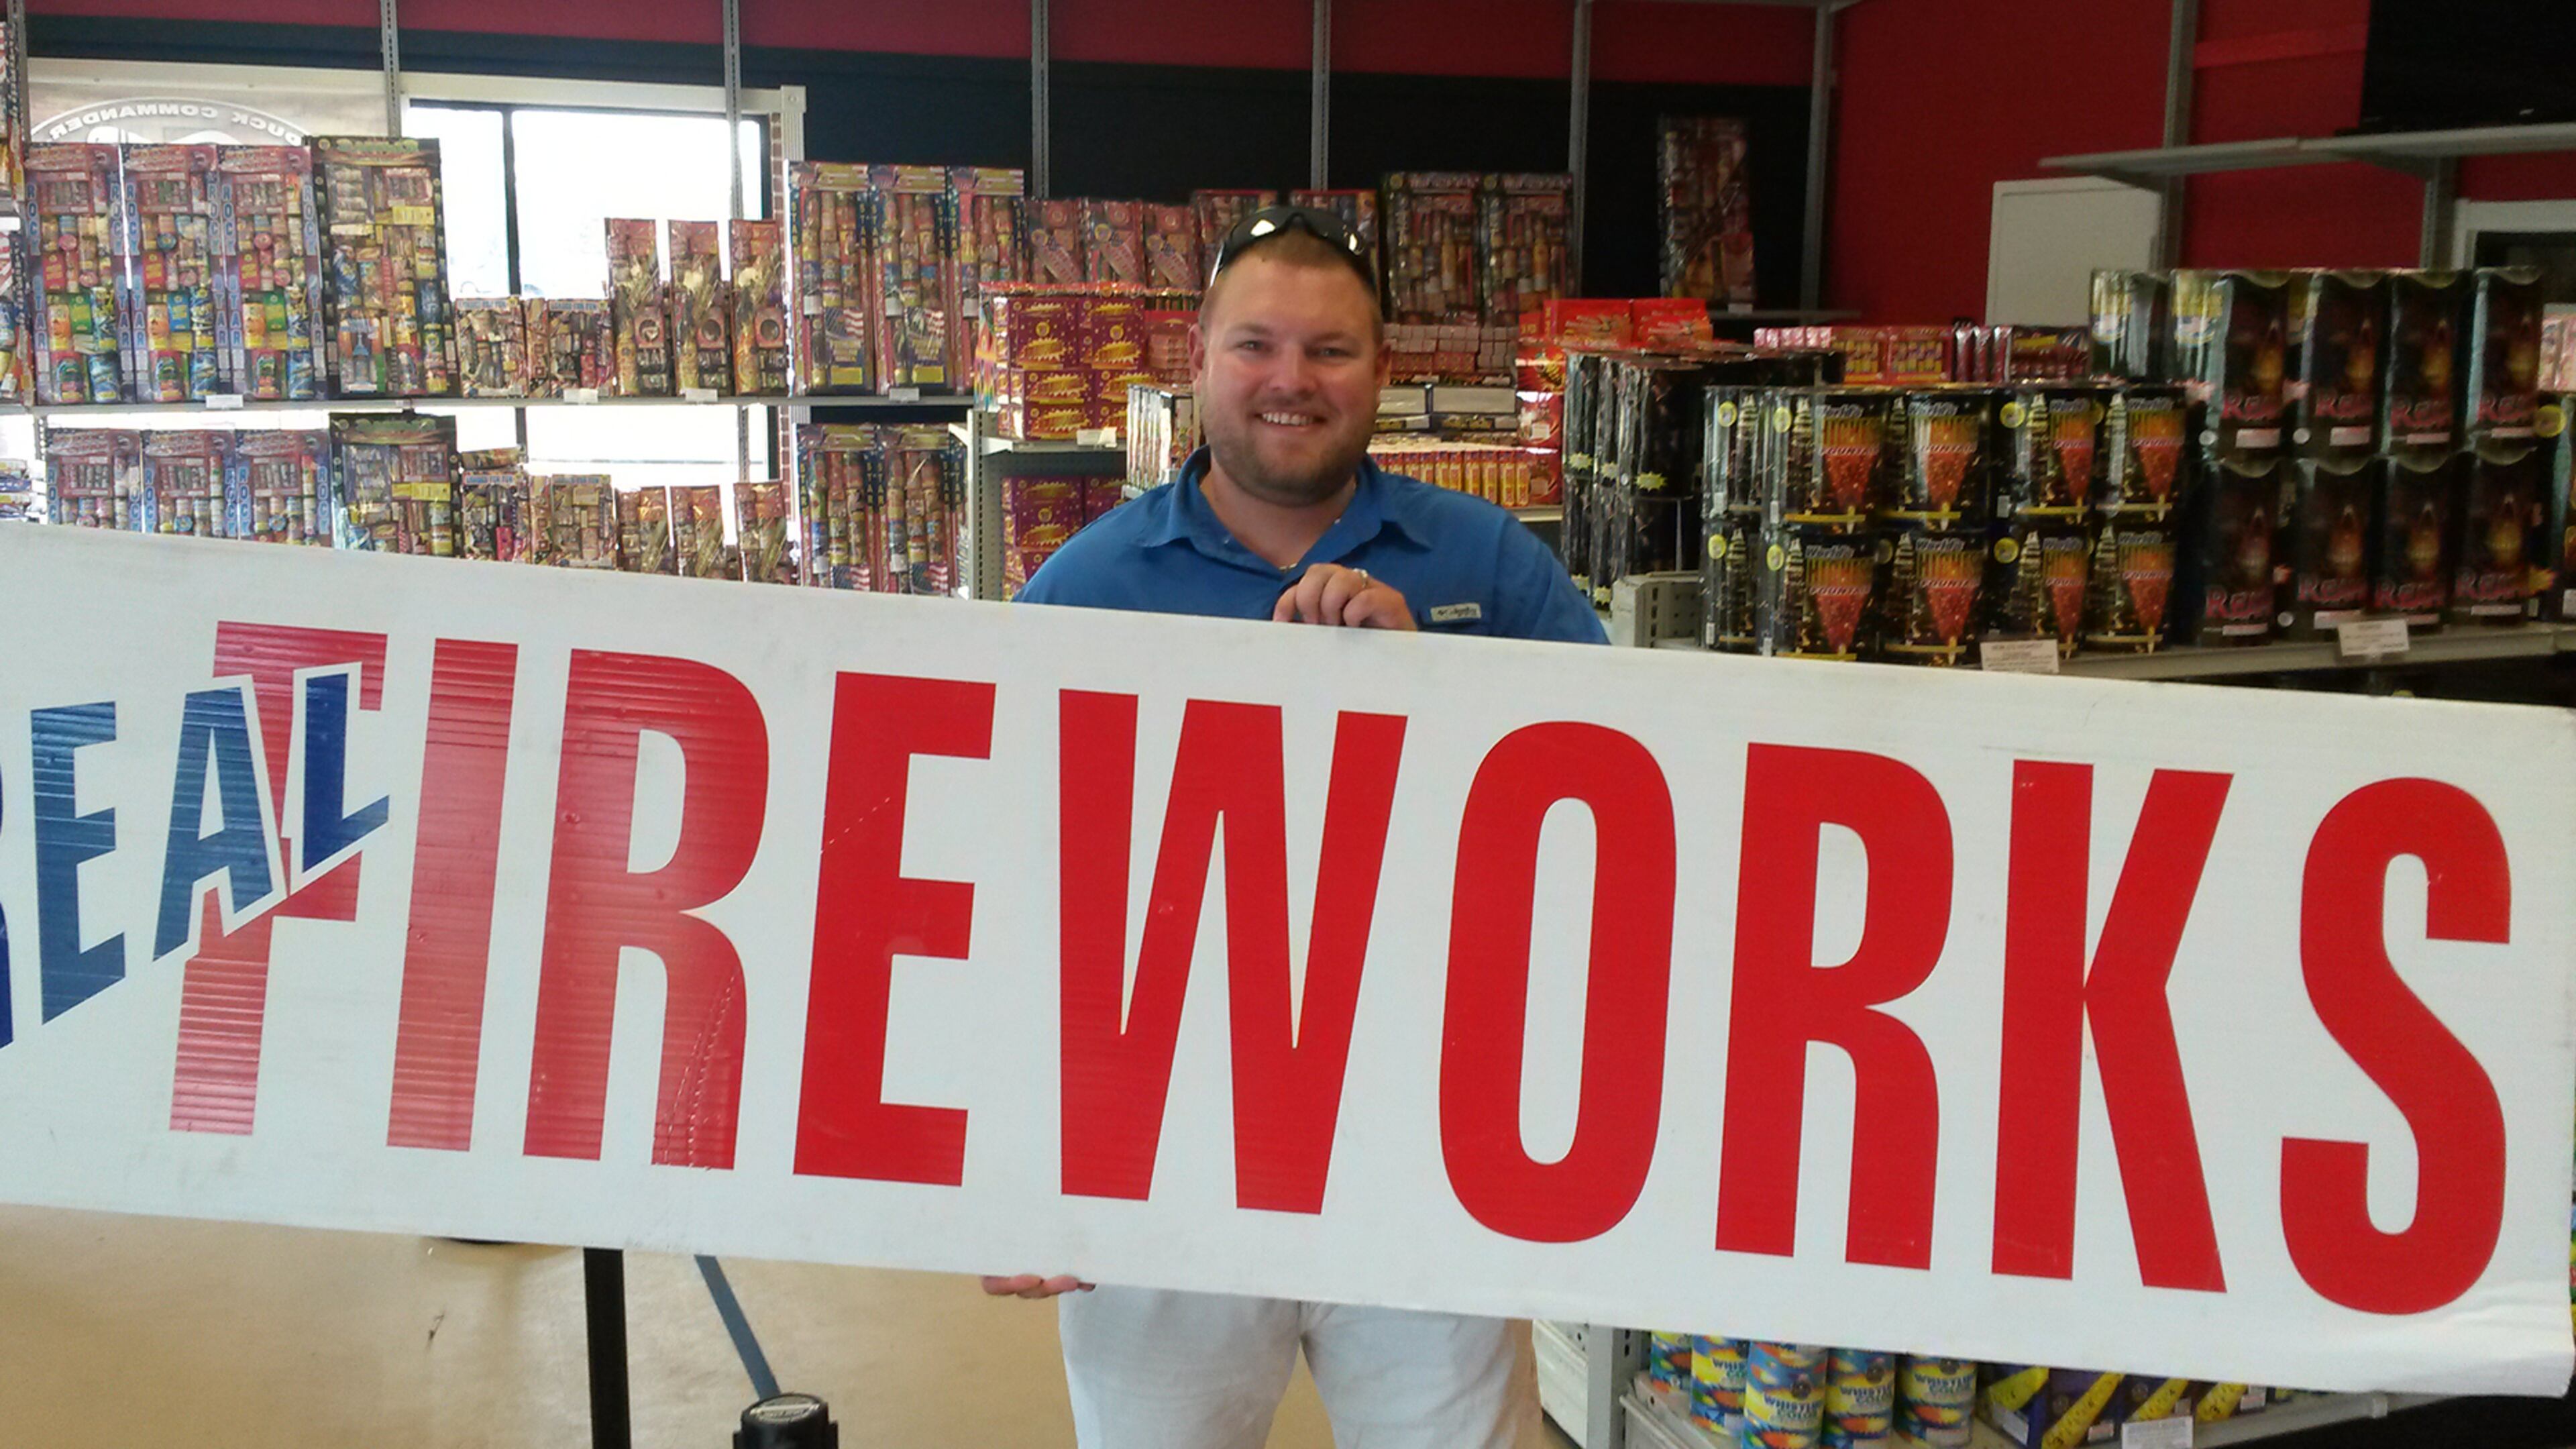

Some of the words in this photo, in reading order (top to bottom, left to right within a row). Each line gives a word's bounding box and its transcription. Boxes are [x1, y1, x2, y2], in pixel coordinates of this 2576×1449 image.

[1805, 544, 1856, 559] World's
[1915, 537, 1966, 552] World's
[0, 672, 390, 1049] EAL
[169, 621, 2512, 1316] FIREWORKS
